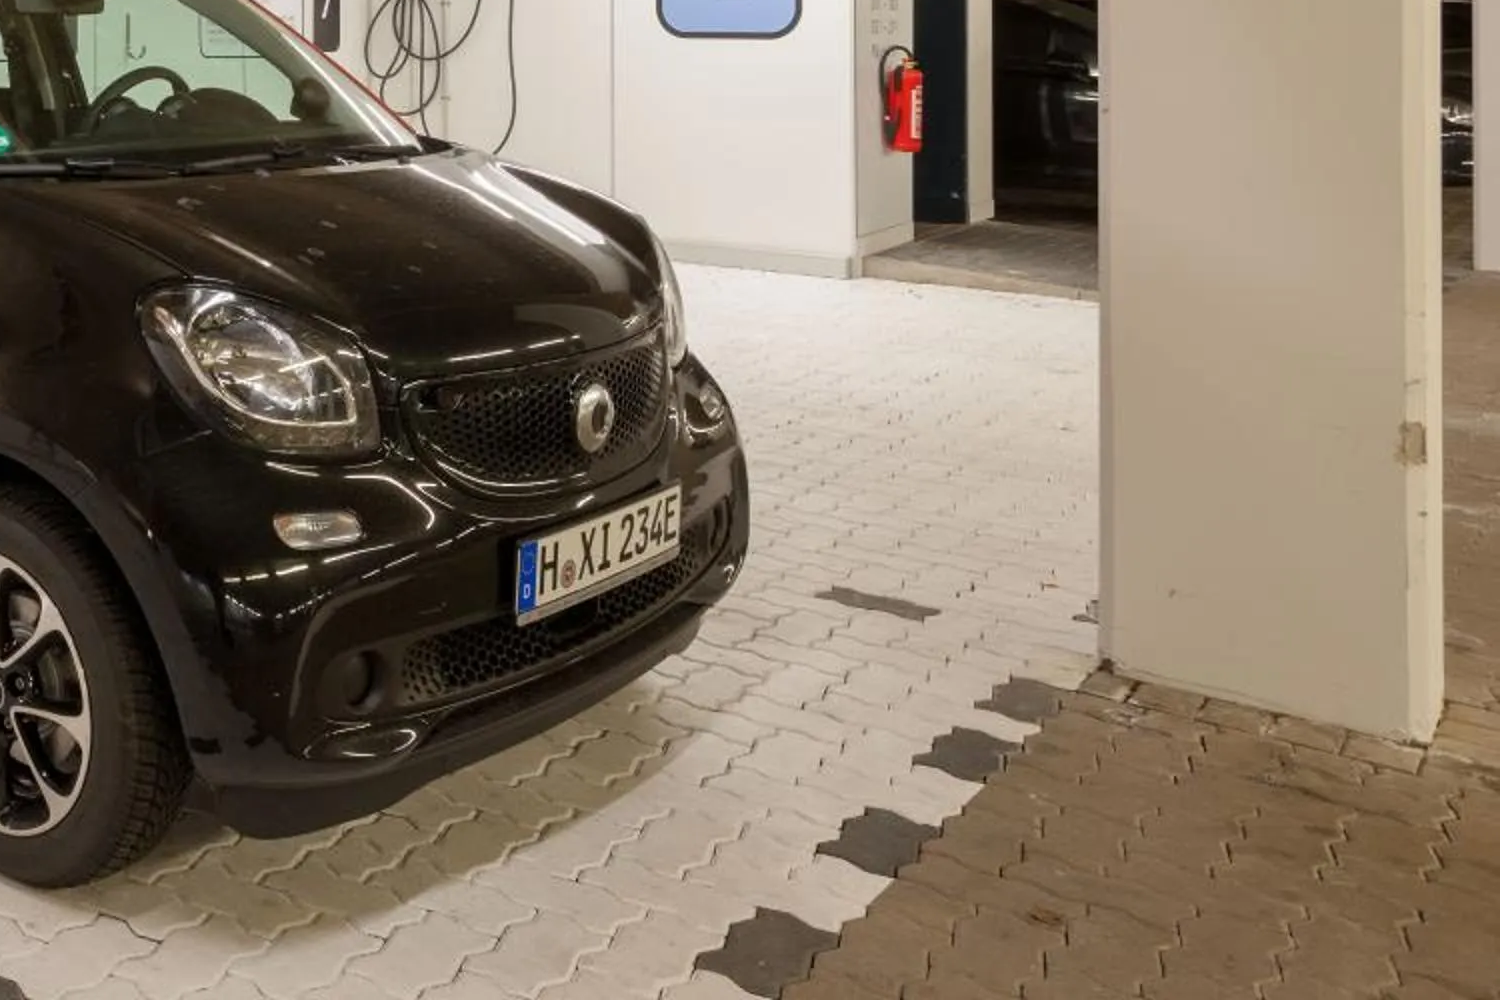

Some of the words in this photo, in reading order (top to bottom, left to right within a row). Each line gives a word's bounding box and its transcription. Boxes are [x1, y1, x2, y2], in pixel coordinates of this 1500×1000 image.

[538, 541, 560, 596] H
[578, 522, 612, 581] XI
[619, 493, 679, 563] 234E
[523, 583, 531, 599] D
